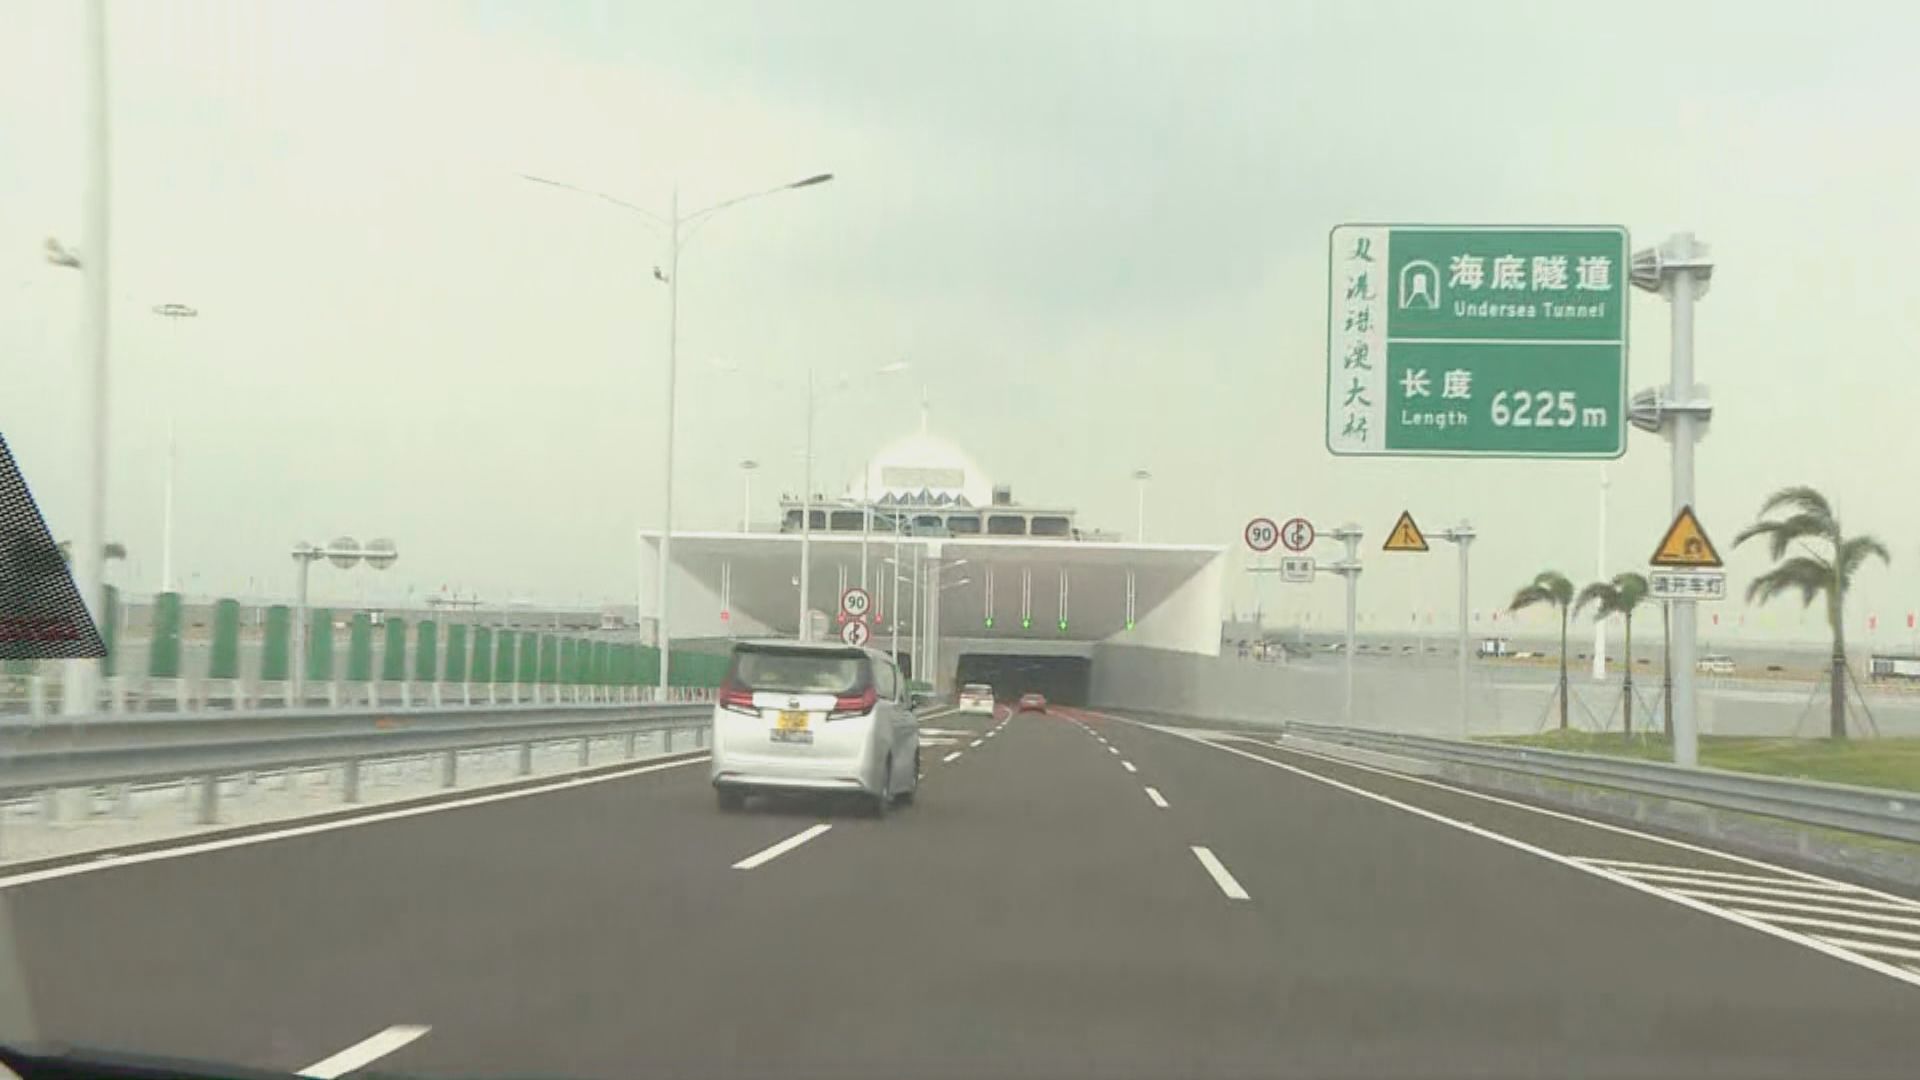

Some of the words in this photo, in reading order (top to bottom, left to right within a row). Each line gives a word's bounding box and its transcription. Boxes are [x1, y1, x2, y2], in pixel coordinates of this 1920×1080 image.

[1448, 253, 1613, 291] 海底隧道
[1454, 300, 1537, 318] Undersea
[1541, 301, 1606, 318] Tunnel
[1399, 368, 1472, 400] 长度
[1401, 410, 1468, 430] Length
[1252, 527, 1272, 541] 90
[848, 596, 865, 609] 90
